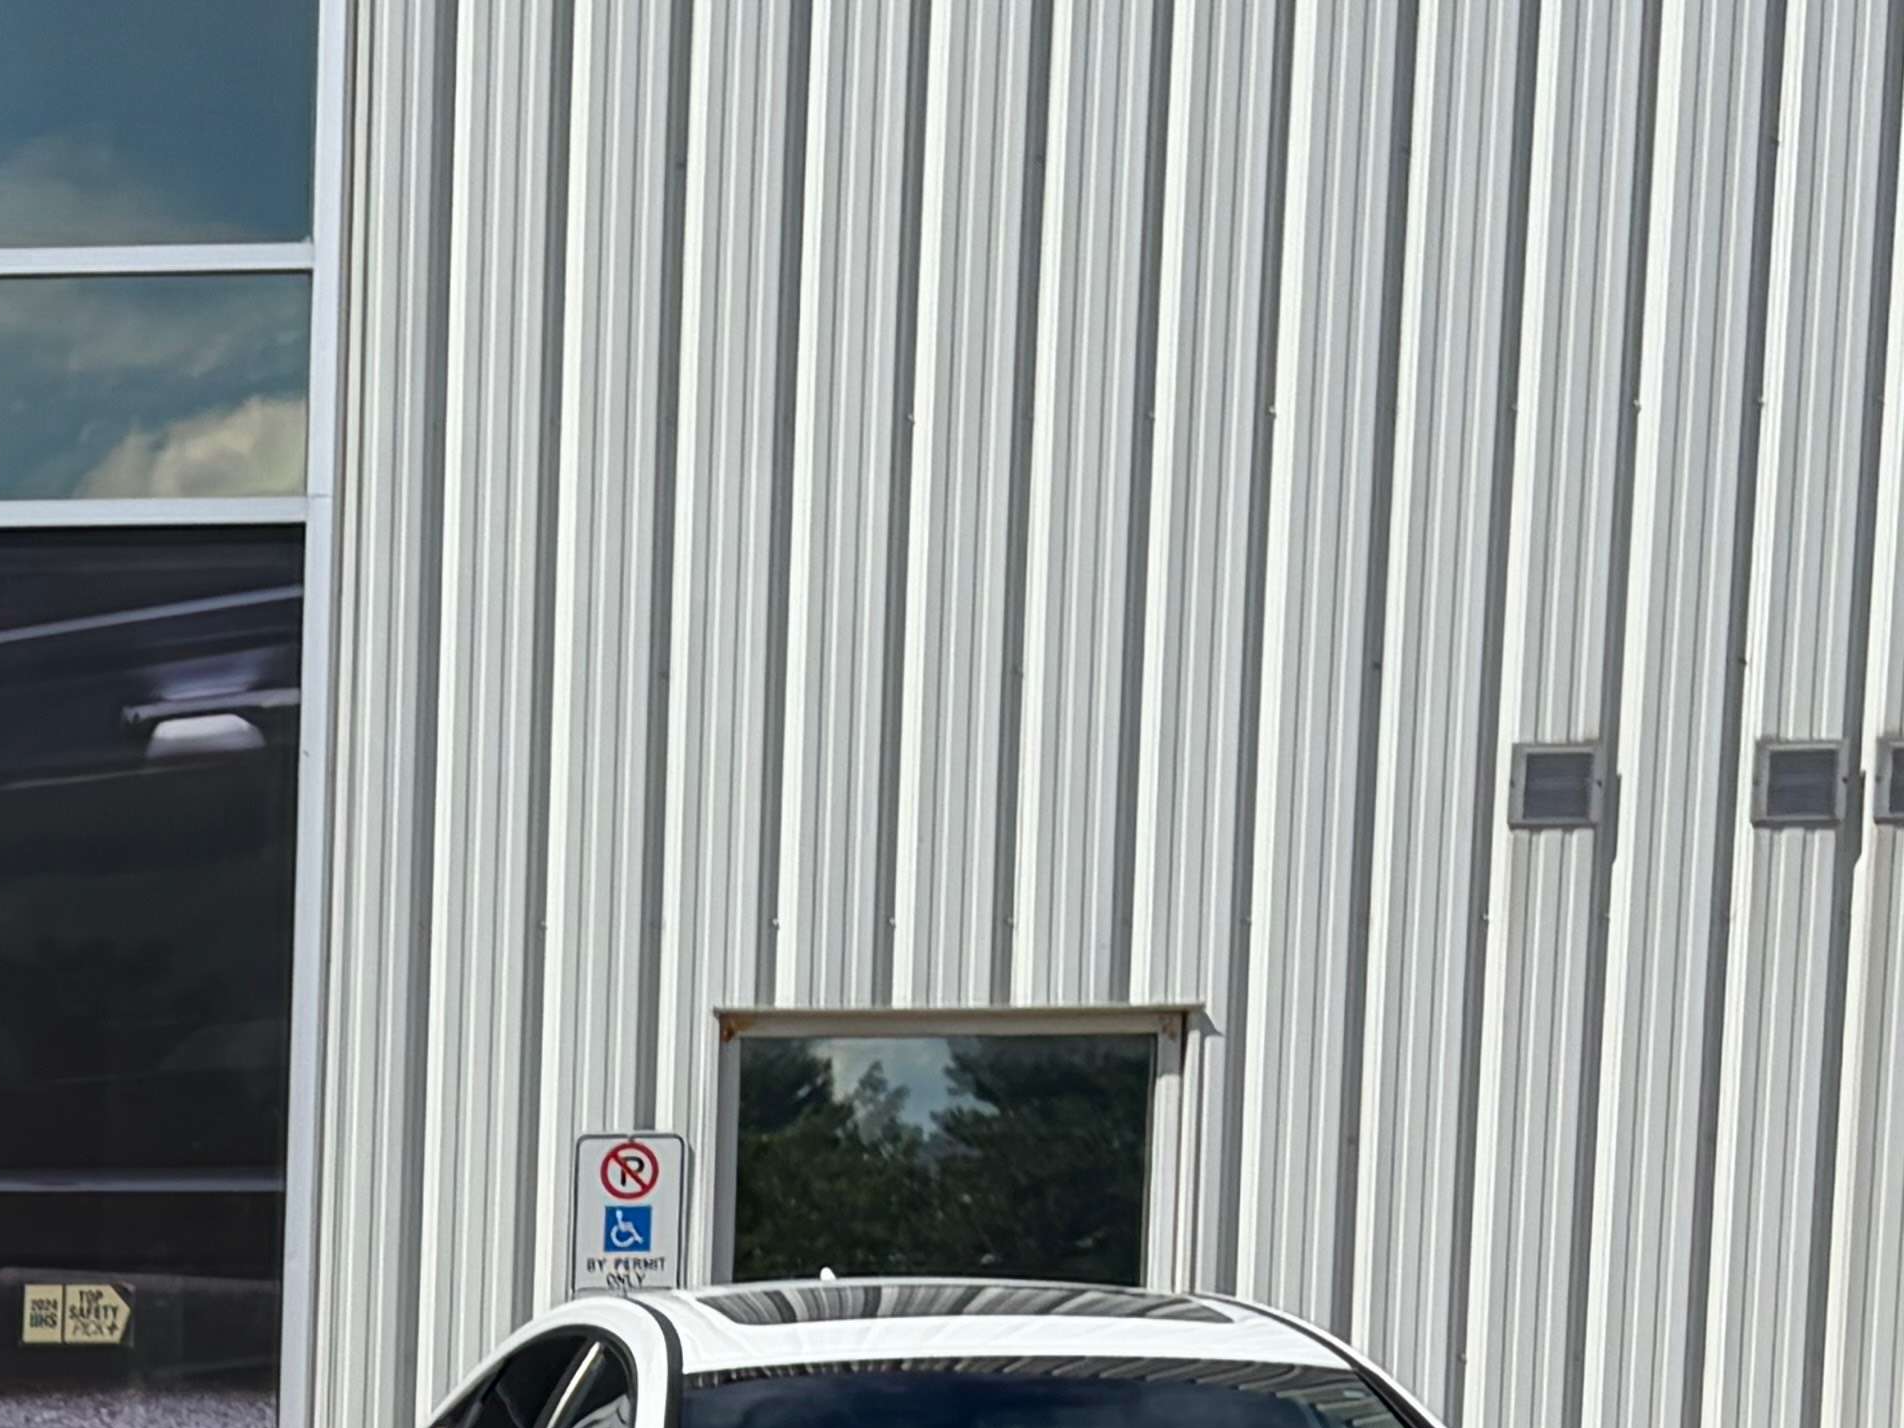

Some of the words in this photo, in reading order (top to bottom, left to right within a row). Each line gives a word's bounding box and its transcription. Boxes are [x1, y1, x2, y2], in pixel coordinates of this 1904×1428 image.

[586, 1257, 607, 1271] BY
[614, 1257, 666, 1271] PERMIT
[606, 1272, 646, 1290] ONLY
